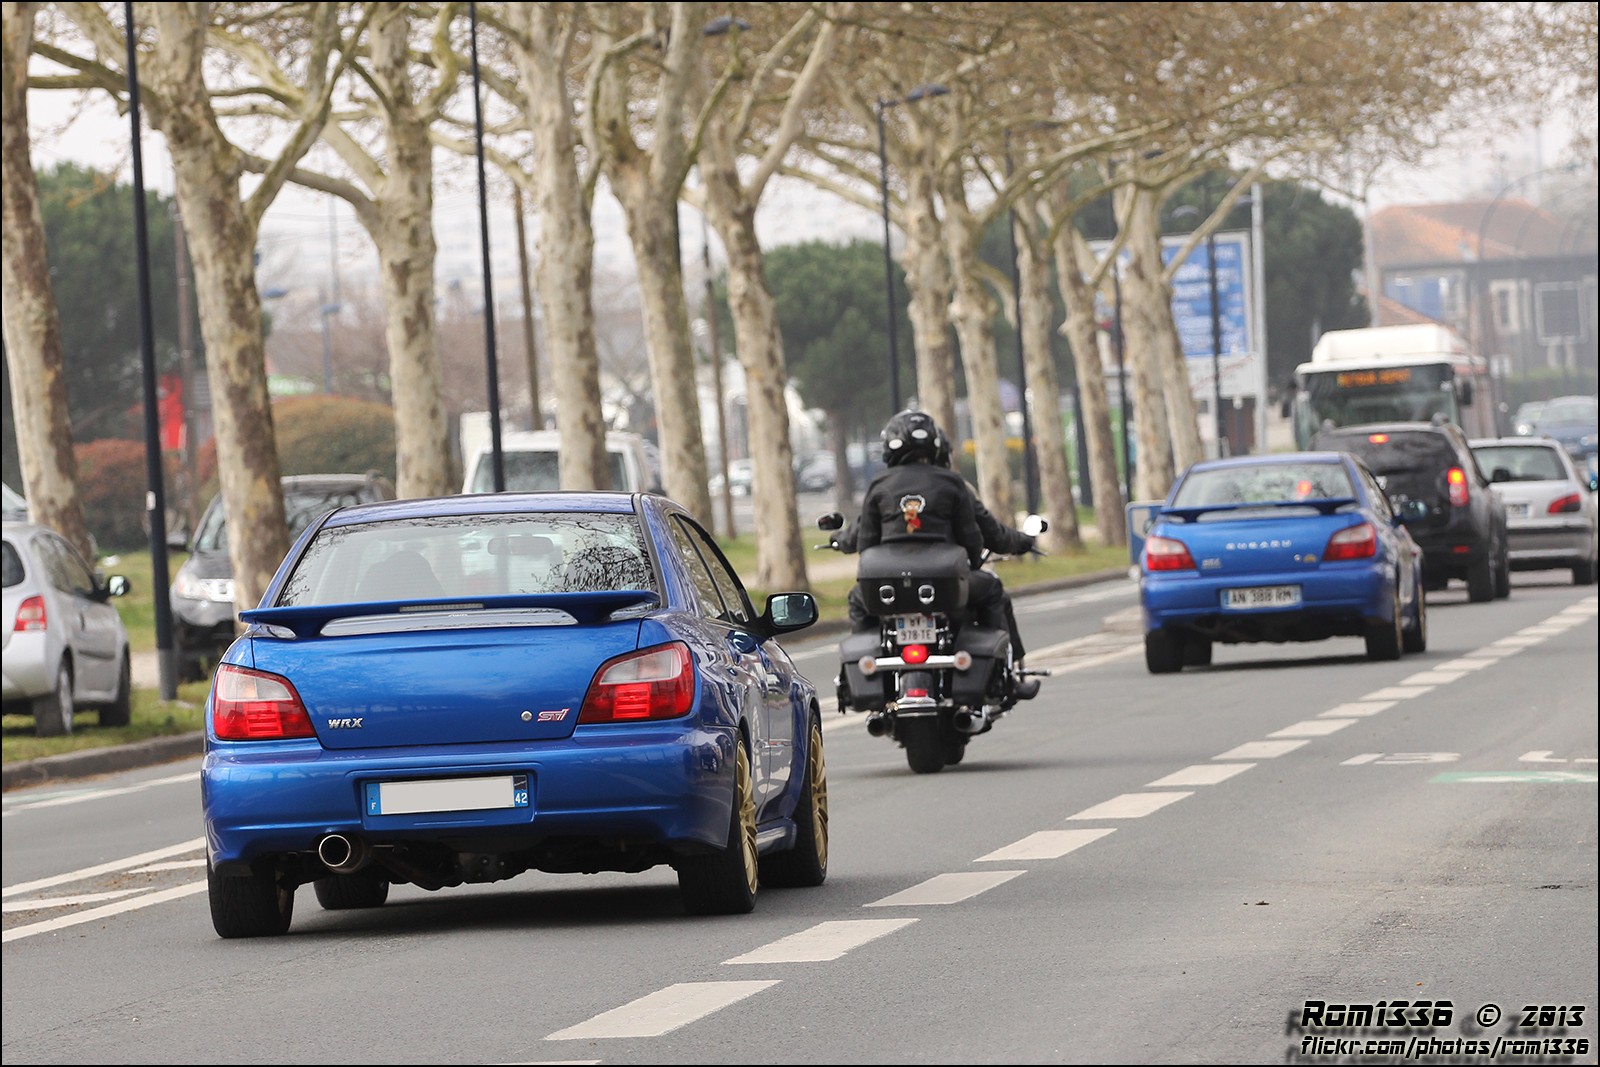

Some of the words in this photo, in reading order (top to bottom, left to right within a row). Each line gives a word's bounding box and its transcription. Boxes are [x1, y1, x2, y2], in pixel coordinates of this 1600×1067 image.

[1225, 540, 1292, 551] SUBARU
[1231, 590, 1246, 603] AN
[328, 717, 364, 729] WRX
[515, 793, 528, 804] 42
[371, 802, 377, 810] F
